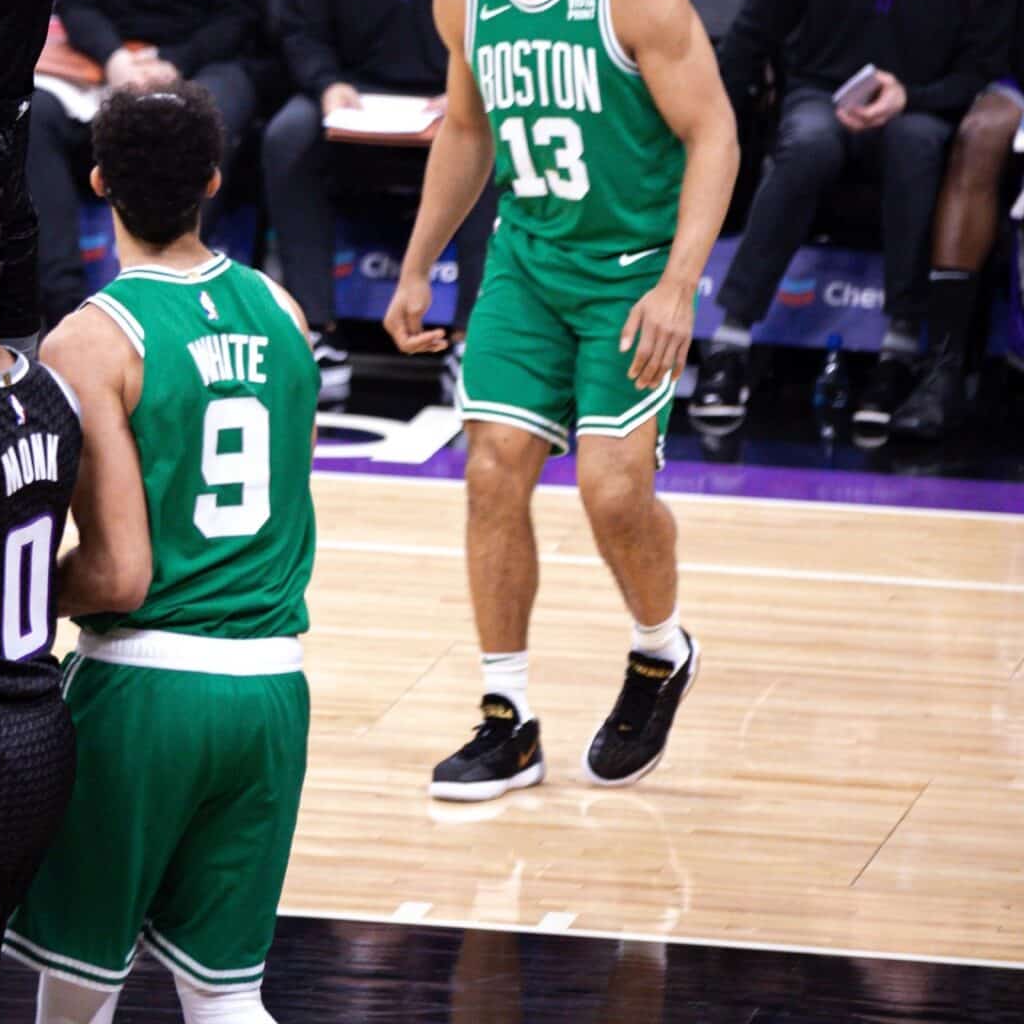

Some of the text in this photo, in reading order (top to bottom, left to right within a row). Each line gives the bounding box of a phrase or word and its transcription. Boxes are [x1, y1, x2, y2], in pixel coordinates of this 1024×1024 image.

[478, 39, 602, 113] BOSTON
[499, 116, 590, 201] 13
[186, 333, 269, 387] WHITE
[0, 432, 60, 497] MONK
[193, 396, 271, 539] 9
[3, 513, 54, 661] 0
